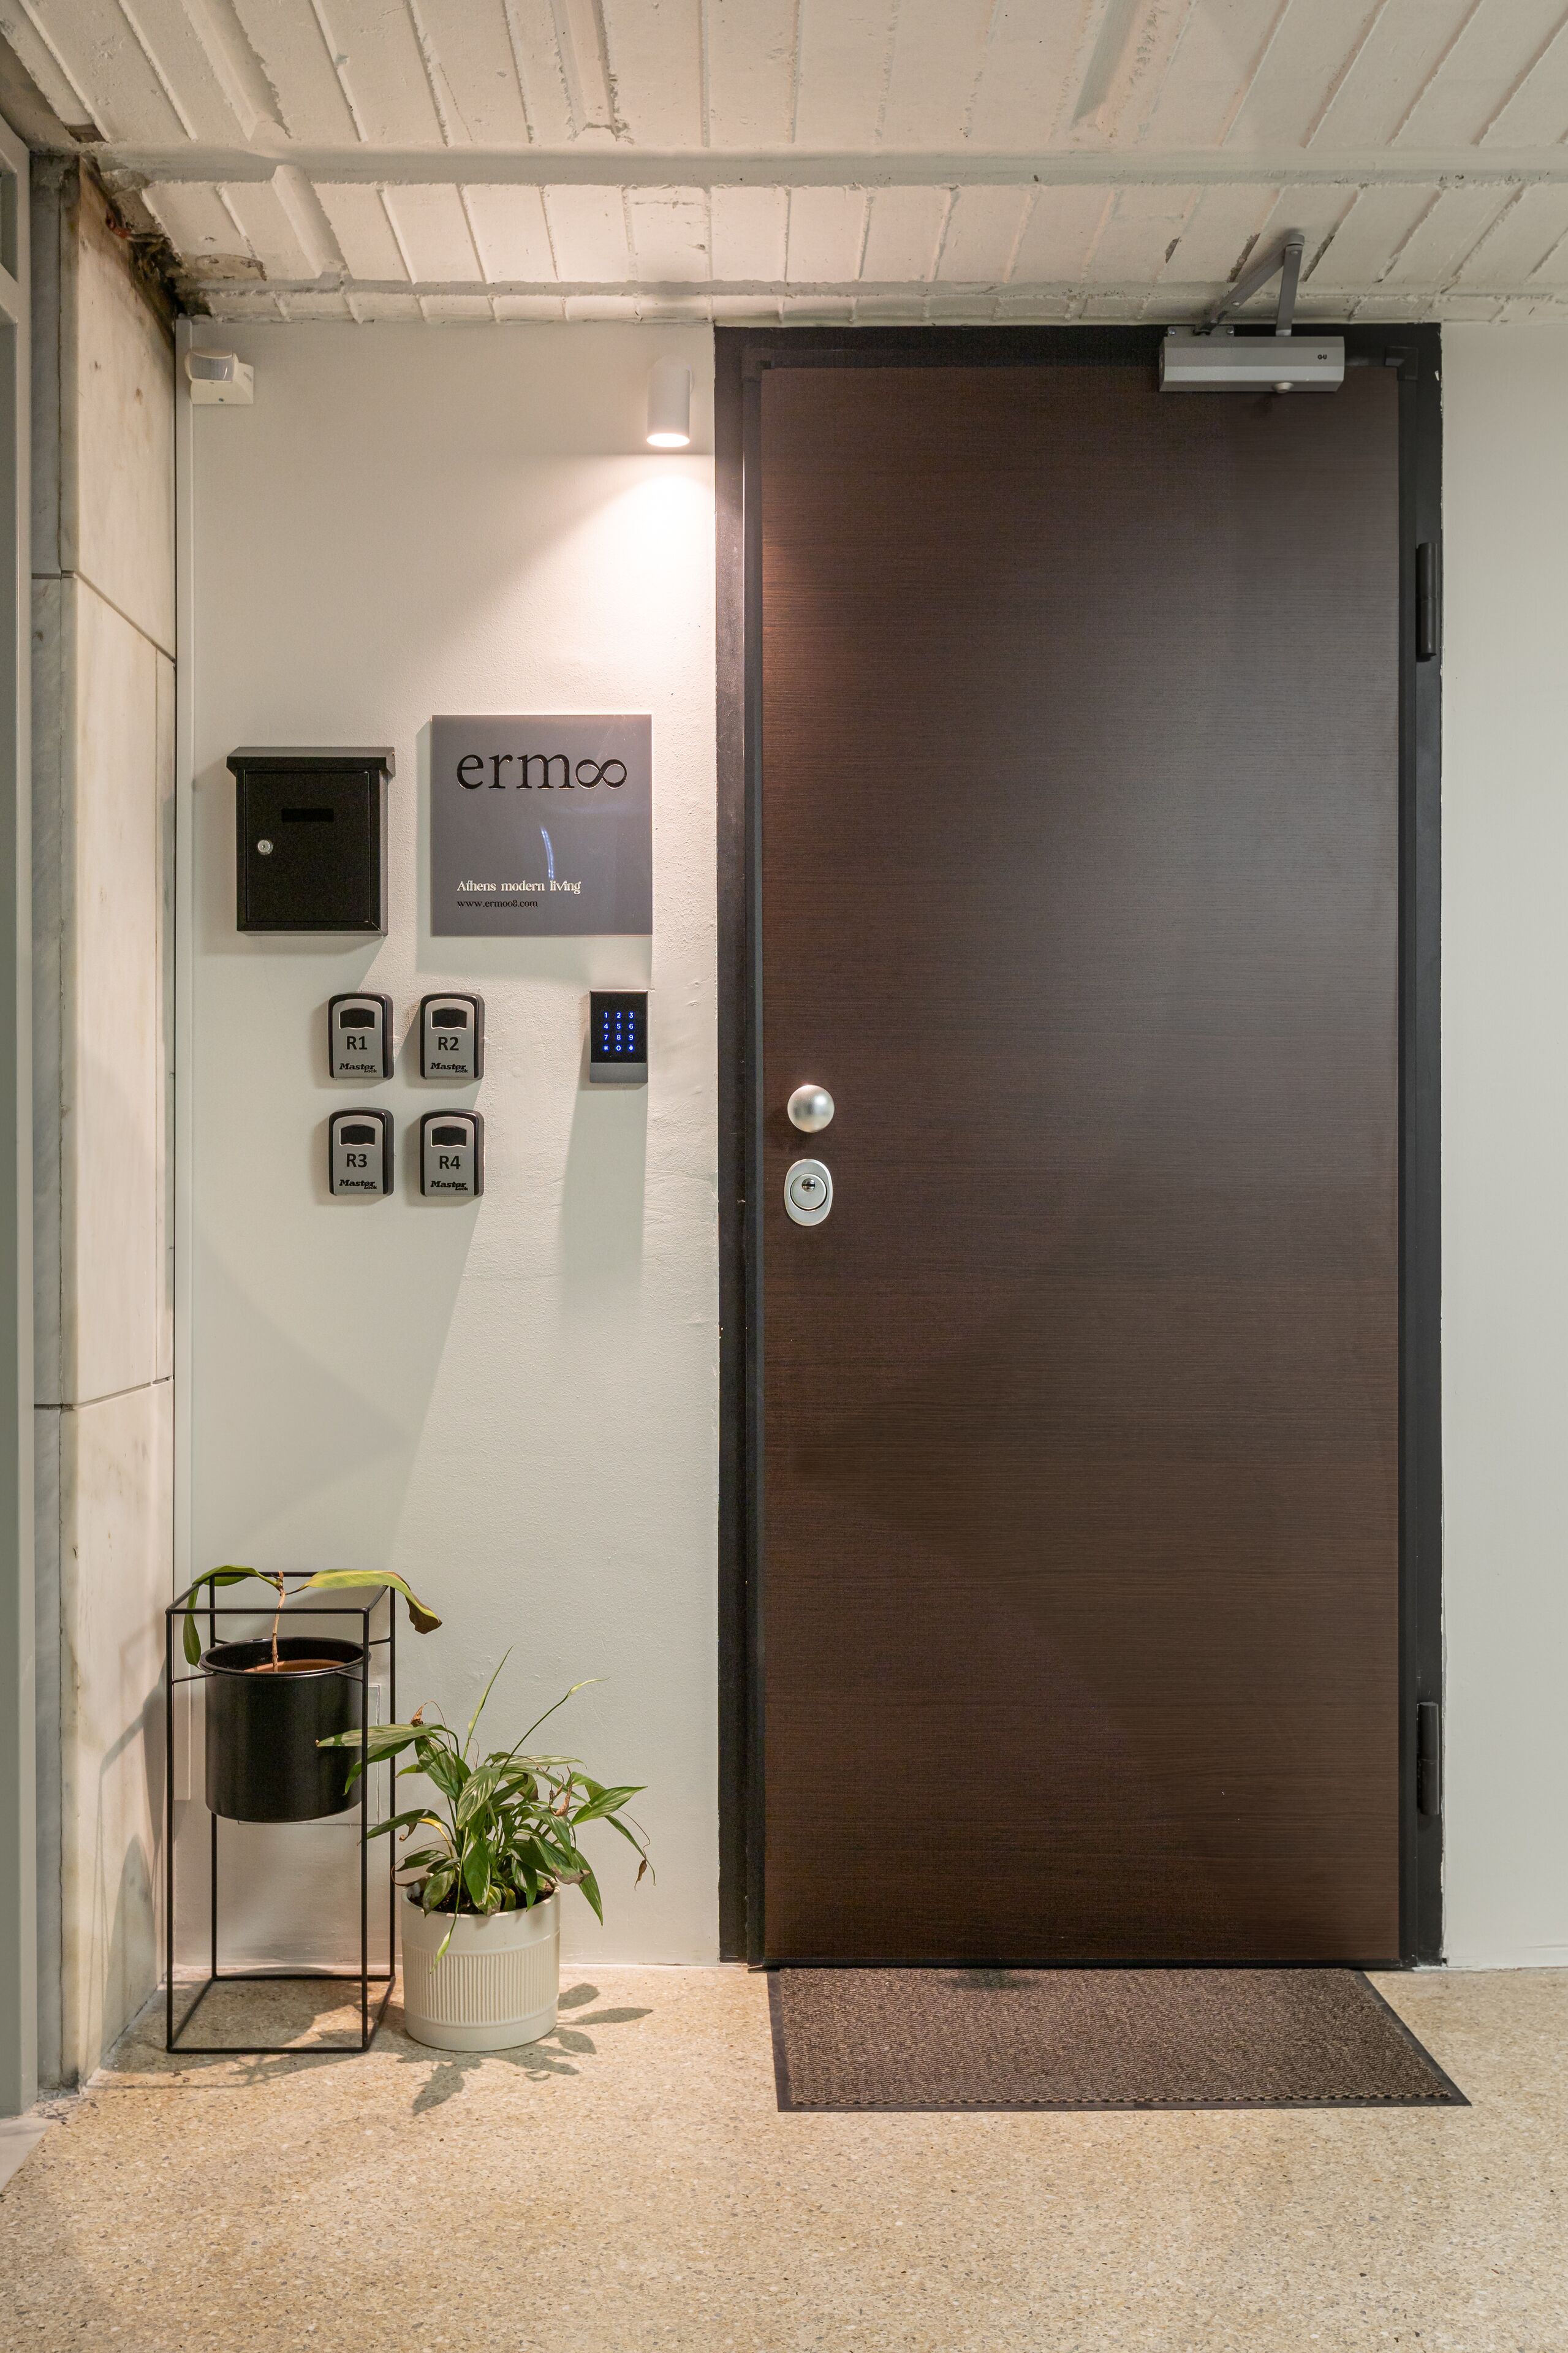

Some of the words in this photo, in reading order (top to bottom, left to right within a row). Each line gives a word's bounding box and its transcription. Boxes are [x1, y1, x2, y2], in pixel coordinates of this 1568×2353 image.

[456, 881, 496, 892] Athens
[501, 880, 545, 892] modern
[550, 880, 581, 895] living
[346, 1036, 368, 1050] R1
[437, 1036, 460, 1051] R2
[346, 1153, 368, 1168] R3
[439, 1155, 461, 1170] R4
